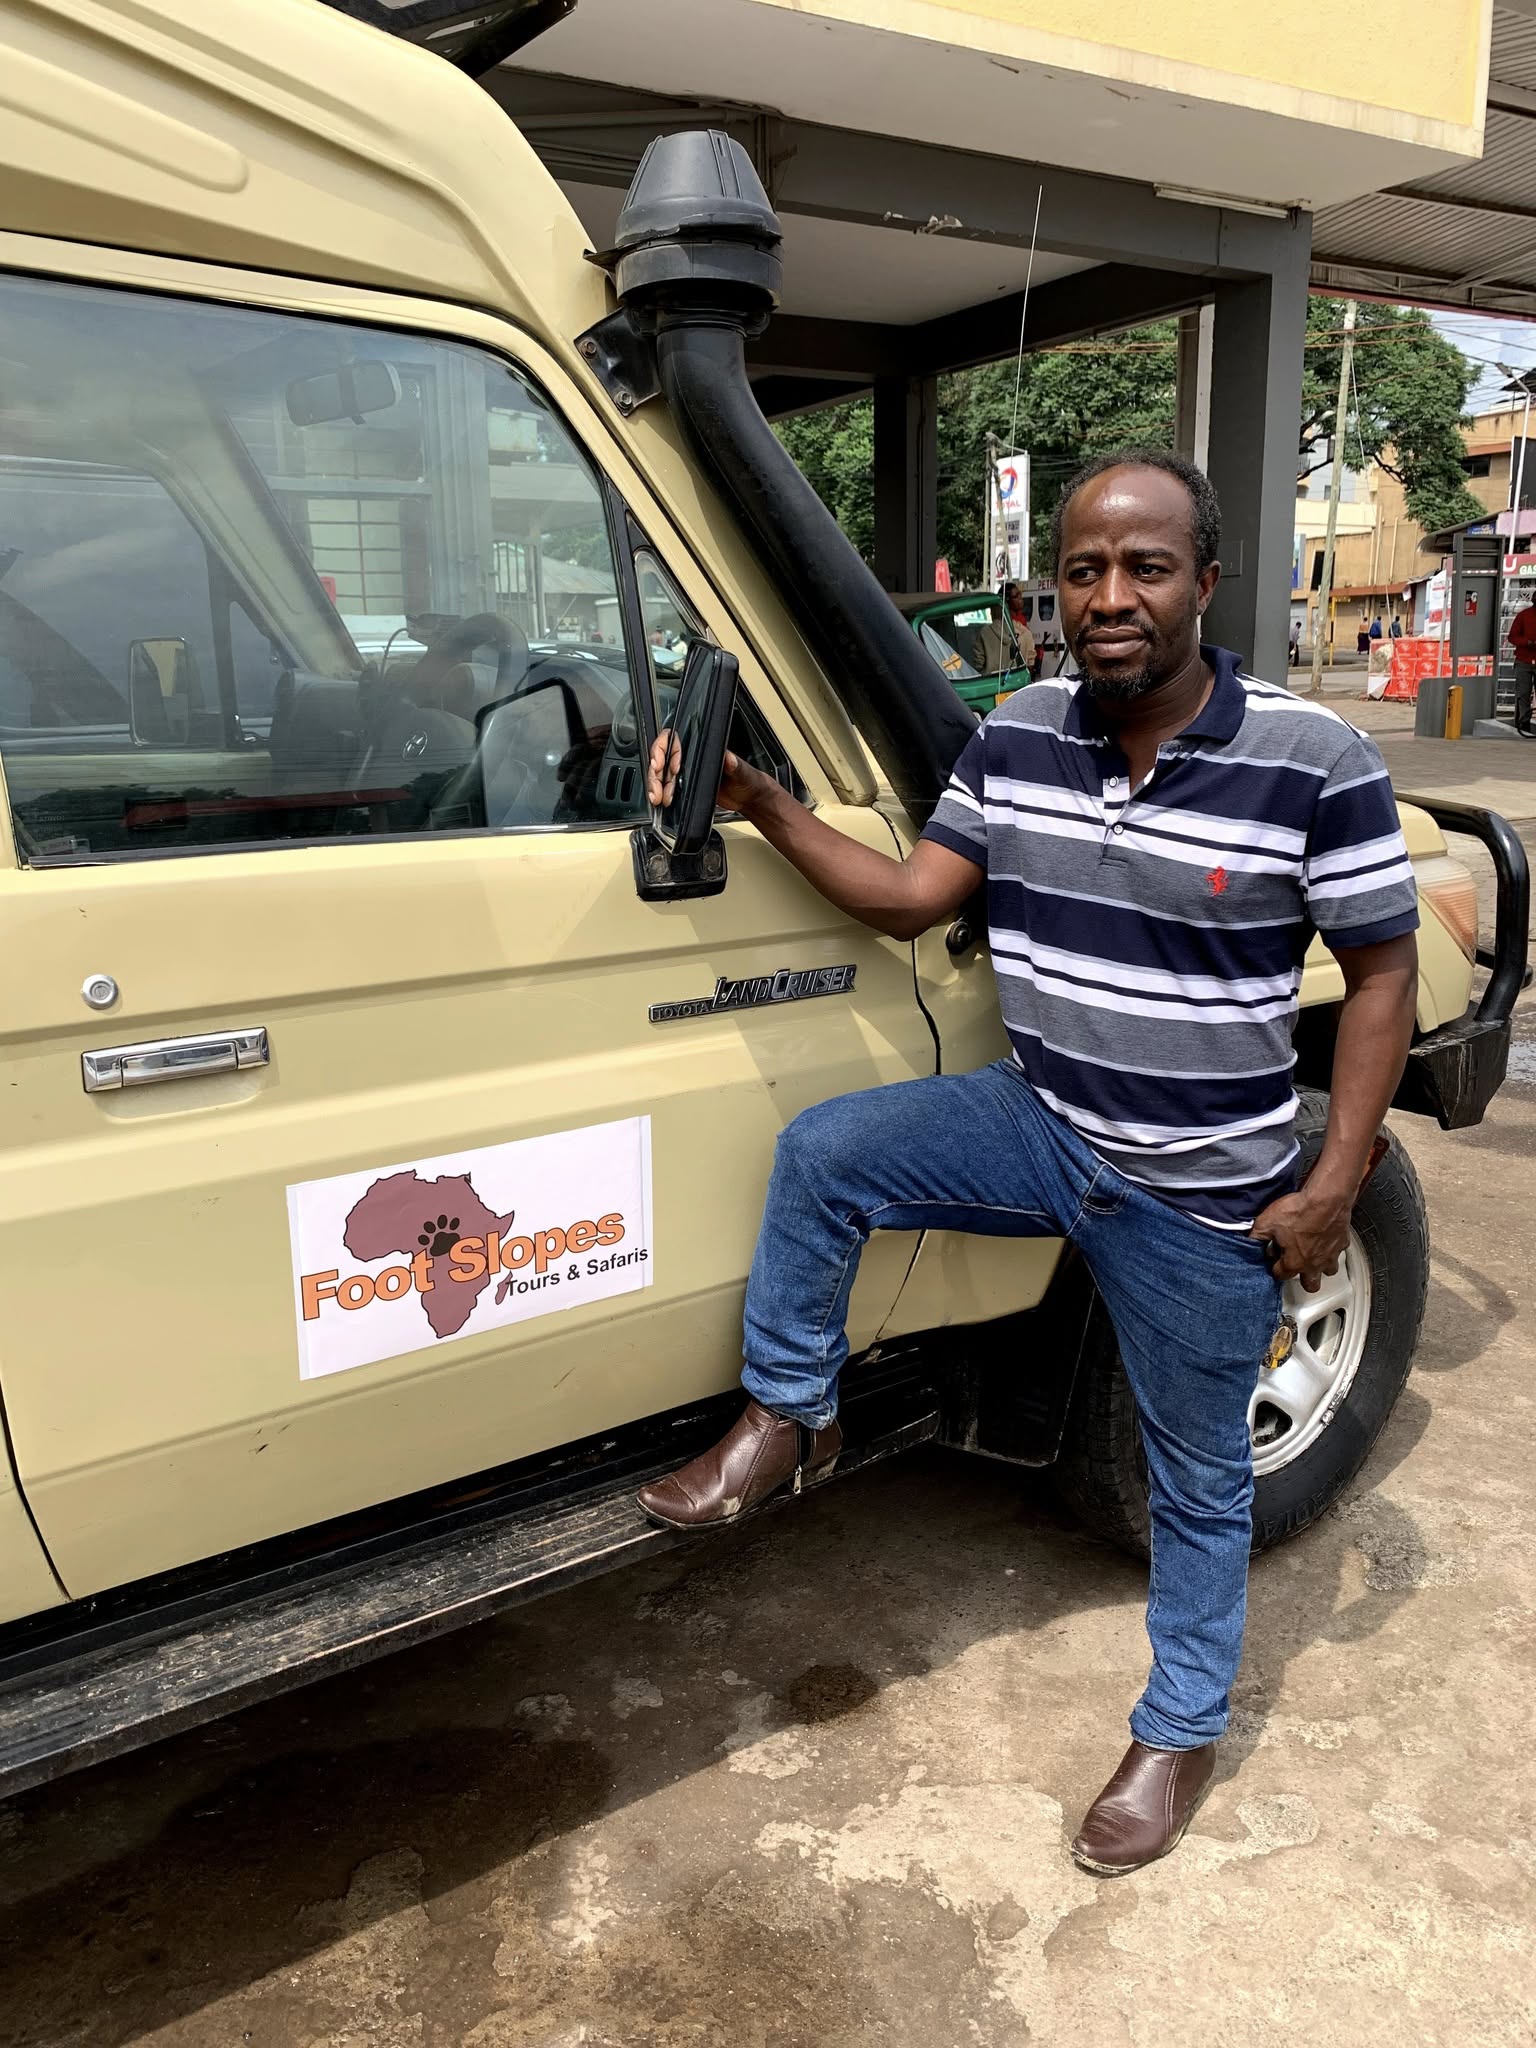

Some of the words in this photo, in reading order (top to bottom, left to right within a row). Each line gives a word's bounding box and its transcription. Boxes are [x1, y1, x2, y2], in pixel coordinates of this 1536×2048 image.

[651, 1001, 711, 1020] TOYOTA
[300, 1249, 435, 1321] Foot
[447, 1212, 626, 1284] Slopes
[505, 1271, 561, 1298] Tours
[567, 1264, 581, 1281] &
[586, 1246, 649, 1276] Safaris
